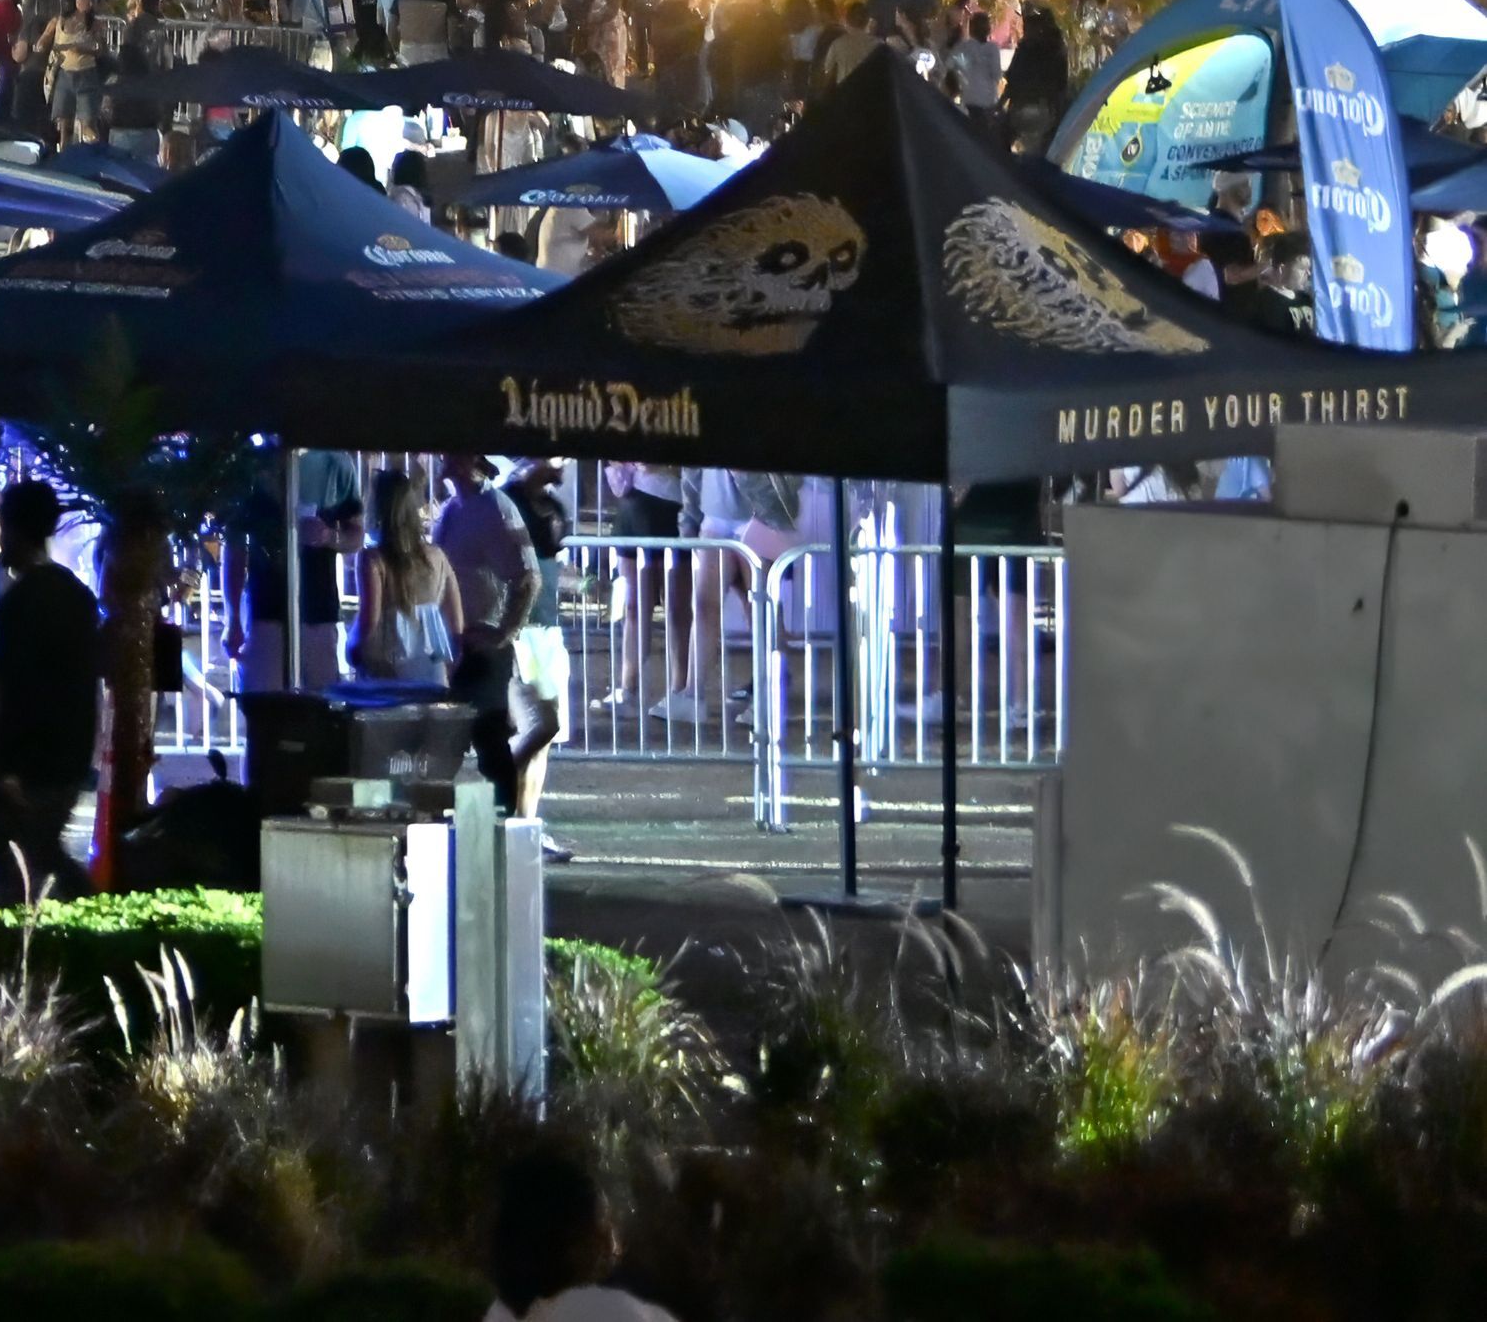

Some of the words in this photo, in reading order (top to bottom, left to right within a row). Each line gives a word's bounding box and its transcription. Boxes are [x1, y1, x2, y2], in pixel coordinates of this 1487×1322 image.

[500, 375, 603, 441] Liquid
[605, 380, 700, 438] Death
[1058, 399, 1185, 444] MURDER
[1204, 393, 1283, 429] YOUR
[1301, 386, 1409, 423] THIRST
